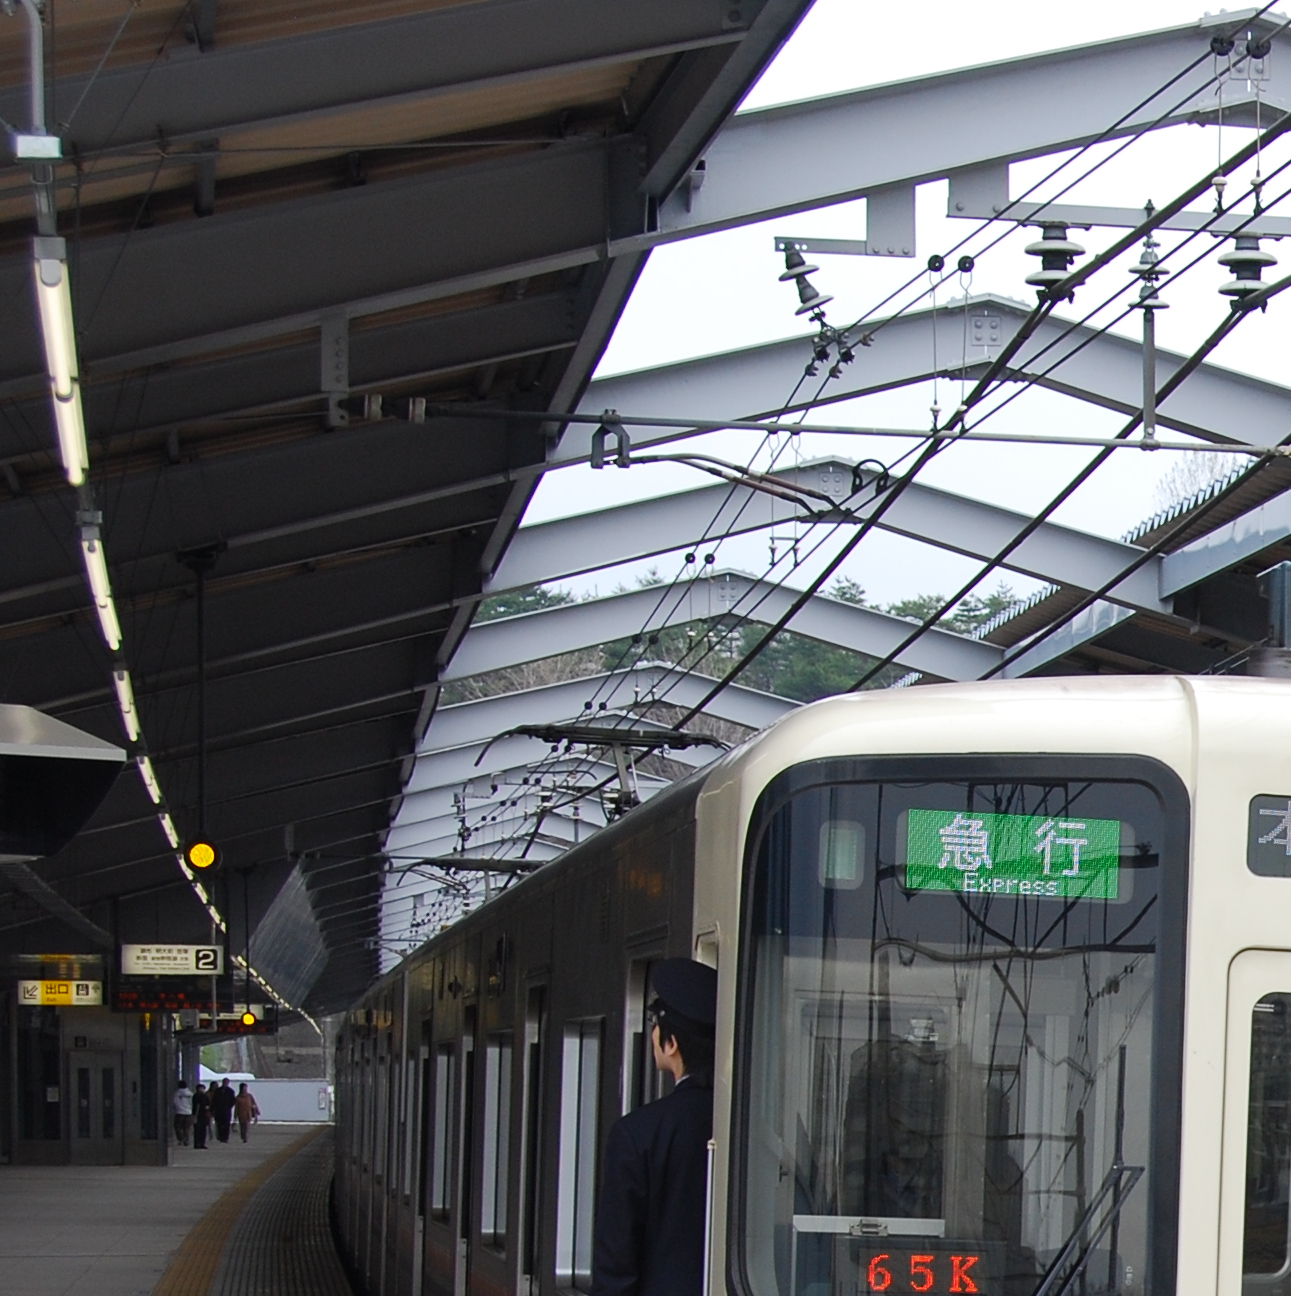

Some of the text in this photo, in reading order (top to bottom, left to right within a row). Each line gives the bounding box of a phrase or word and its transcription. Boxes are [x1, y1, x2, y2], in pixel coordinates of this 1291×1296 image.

[938, 813, 1088, 877] 急行
[963, 872, 1058, 896] Express
[198, 950, 215, 969] 2
[867, 1254, 979, 1293] 65K
